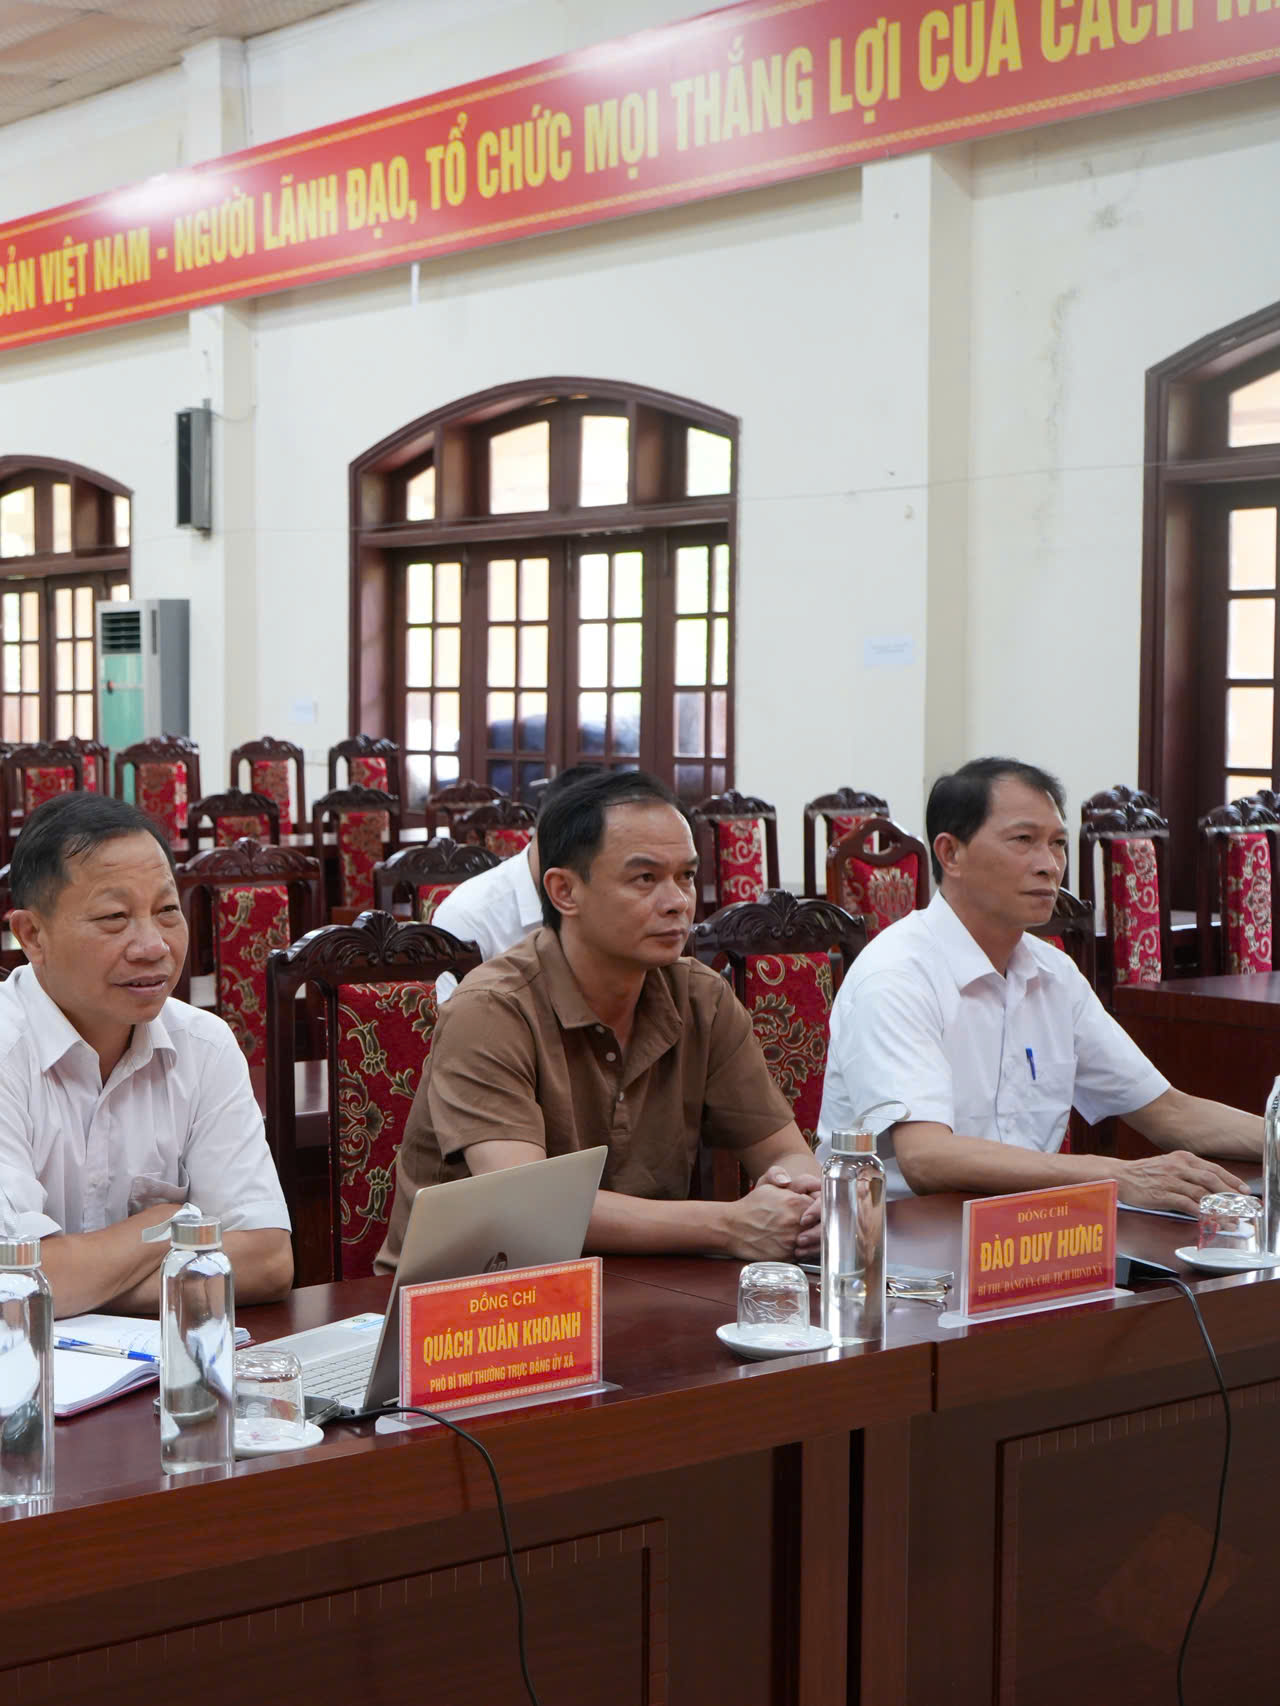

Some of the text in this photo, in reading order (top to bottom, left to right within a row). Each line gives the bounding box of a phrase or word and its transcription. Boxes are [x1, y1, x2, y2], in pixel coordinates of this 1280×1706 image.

[40, 236, 88, 311] VIỆT
[93, 226, 151, 292] NAM
[174, 186, 255, 273] NGƯỜI
[263, 174, 337, 250] LÃNH
[346, 156, 417, 239] ĐẠO,
[425, 111, 468, 210] TỔ
[477, 104, 571, 199] CHỨC
[584, 89, 659, 179] MỌI
[671, 36, 813, 151] THẮNG
[829, 17, 901, 124] LỢI
[980, 1233, 1015, 1272] ĐÀO
[1020, 1231, 1054, 1265] DUY
[469, 1285, 536, 1313] ĐỒNG CHÍ
[423, 1311, 581, 1366] QUÁCH XUÂN KHOANH
